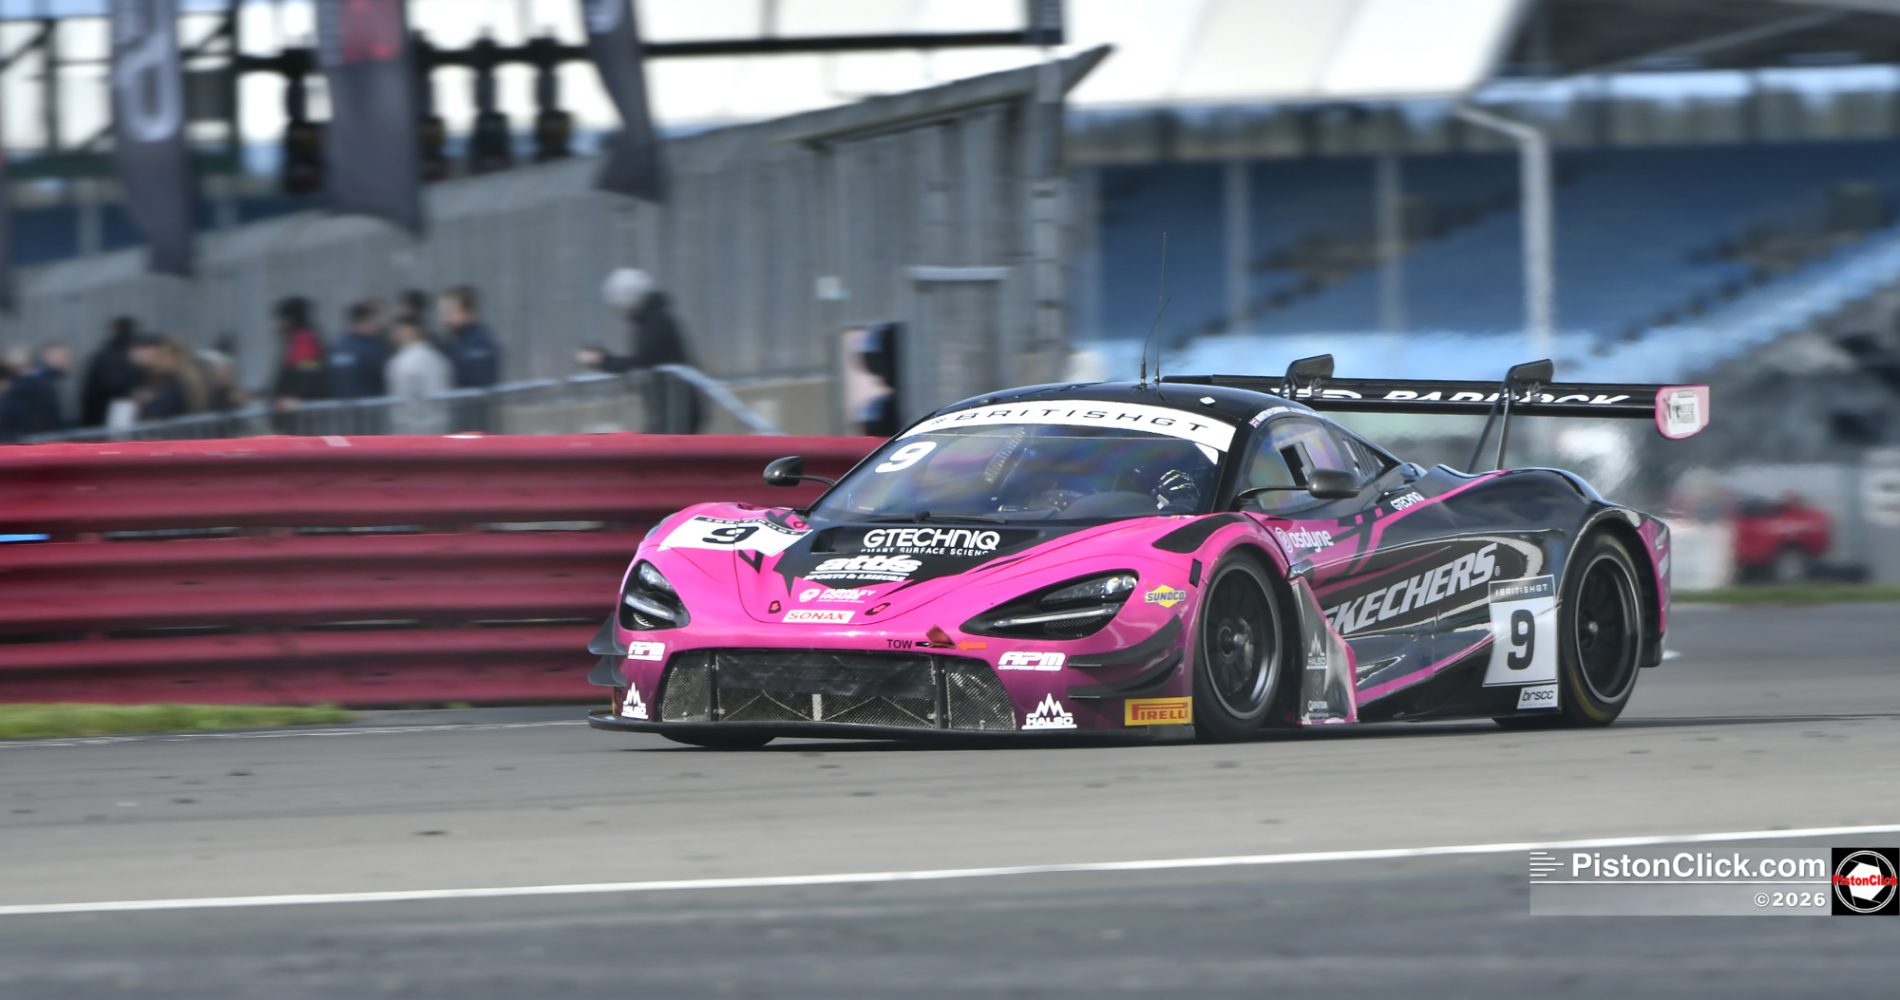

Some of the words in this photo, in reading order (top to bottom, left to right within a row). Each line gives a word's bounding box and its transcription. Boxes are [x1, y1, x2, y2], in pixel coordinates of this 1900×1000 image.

[875, 441, 937, 472] 9
[702, 526, 760, 544] 9
[863, 528, 1000, 550] GTECHNIQ
[1146, 591, 1186, 602] SUNOCO
[788, 612, 845, 620] SONAX
[886, 639, 913, 649] TOW
[1507, 609, 1535, 670] 9
[1131, 702, 1188, 720] PIRELLI
